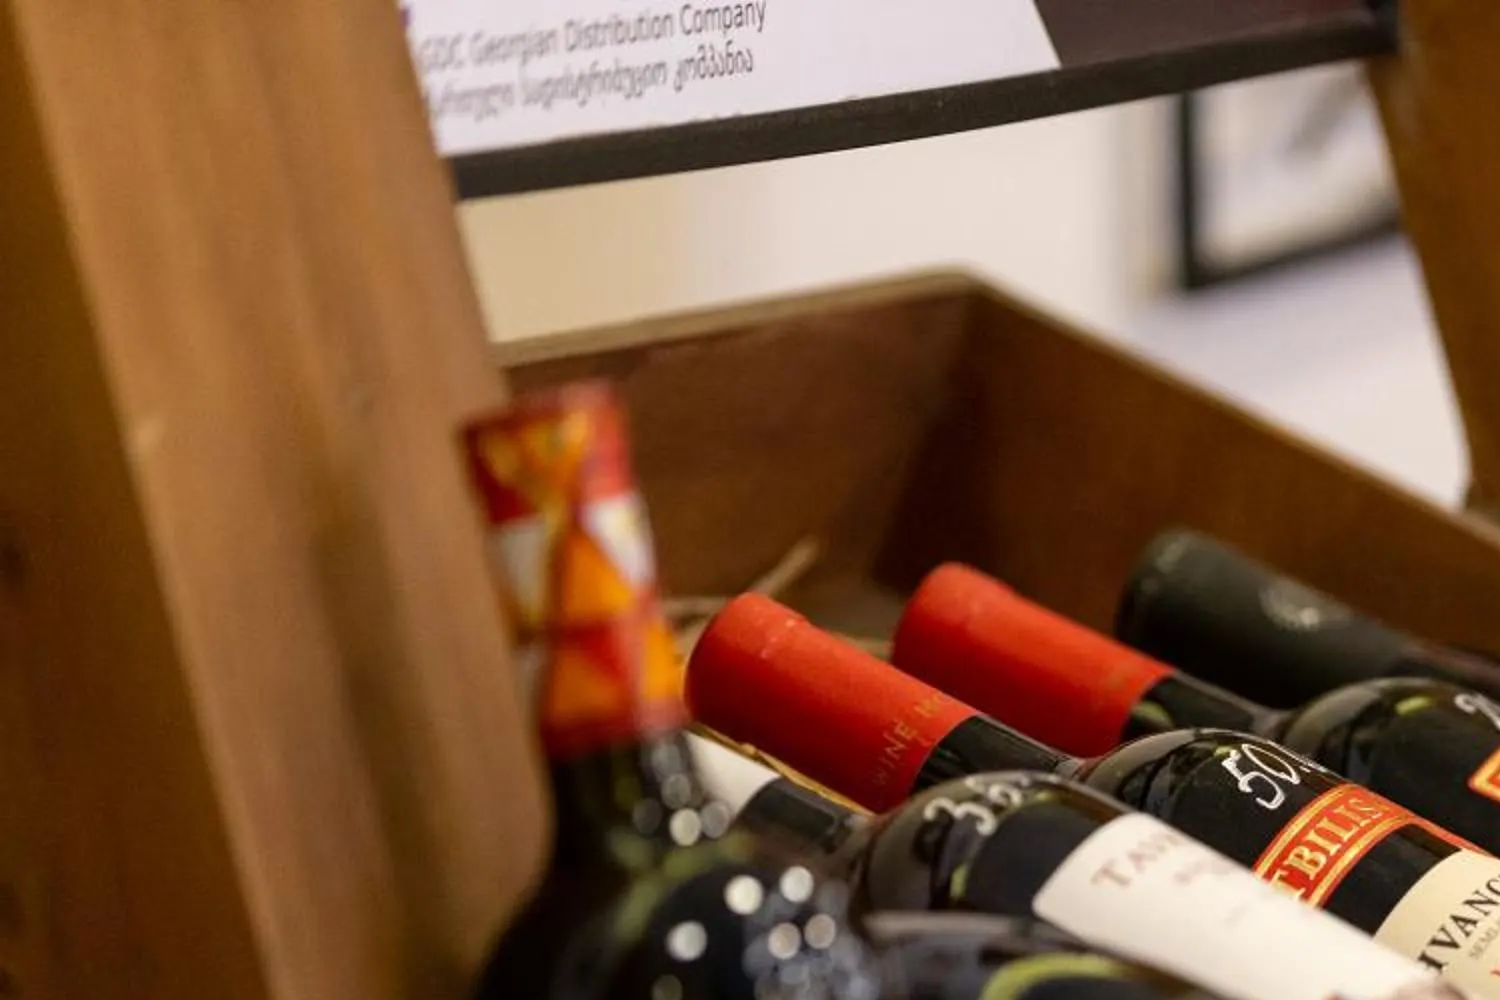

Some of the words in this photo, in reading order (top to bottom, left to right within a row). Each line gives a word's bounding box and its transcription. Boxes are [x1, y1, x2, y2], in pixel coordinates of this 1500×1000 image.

[564, 8, 674, 52] Distribution
[680, 0, 768, 38] Company
[673, 40, 754, 92] კომპანია
